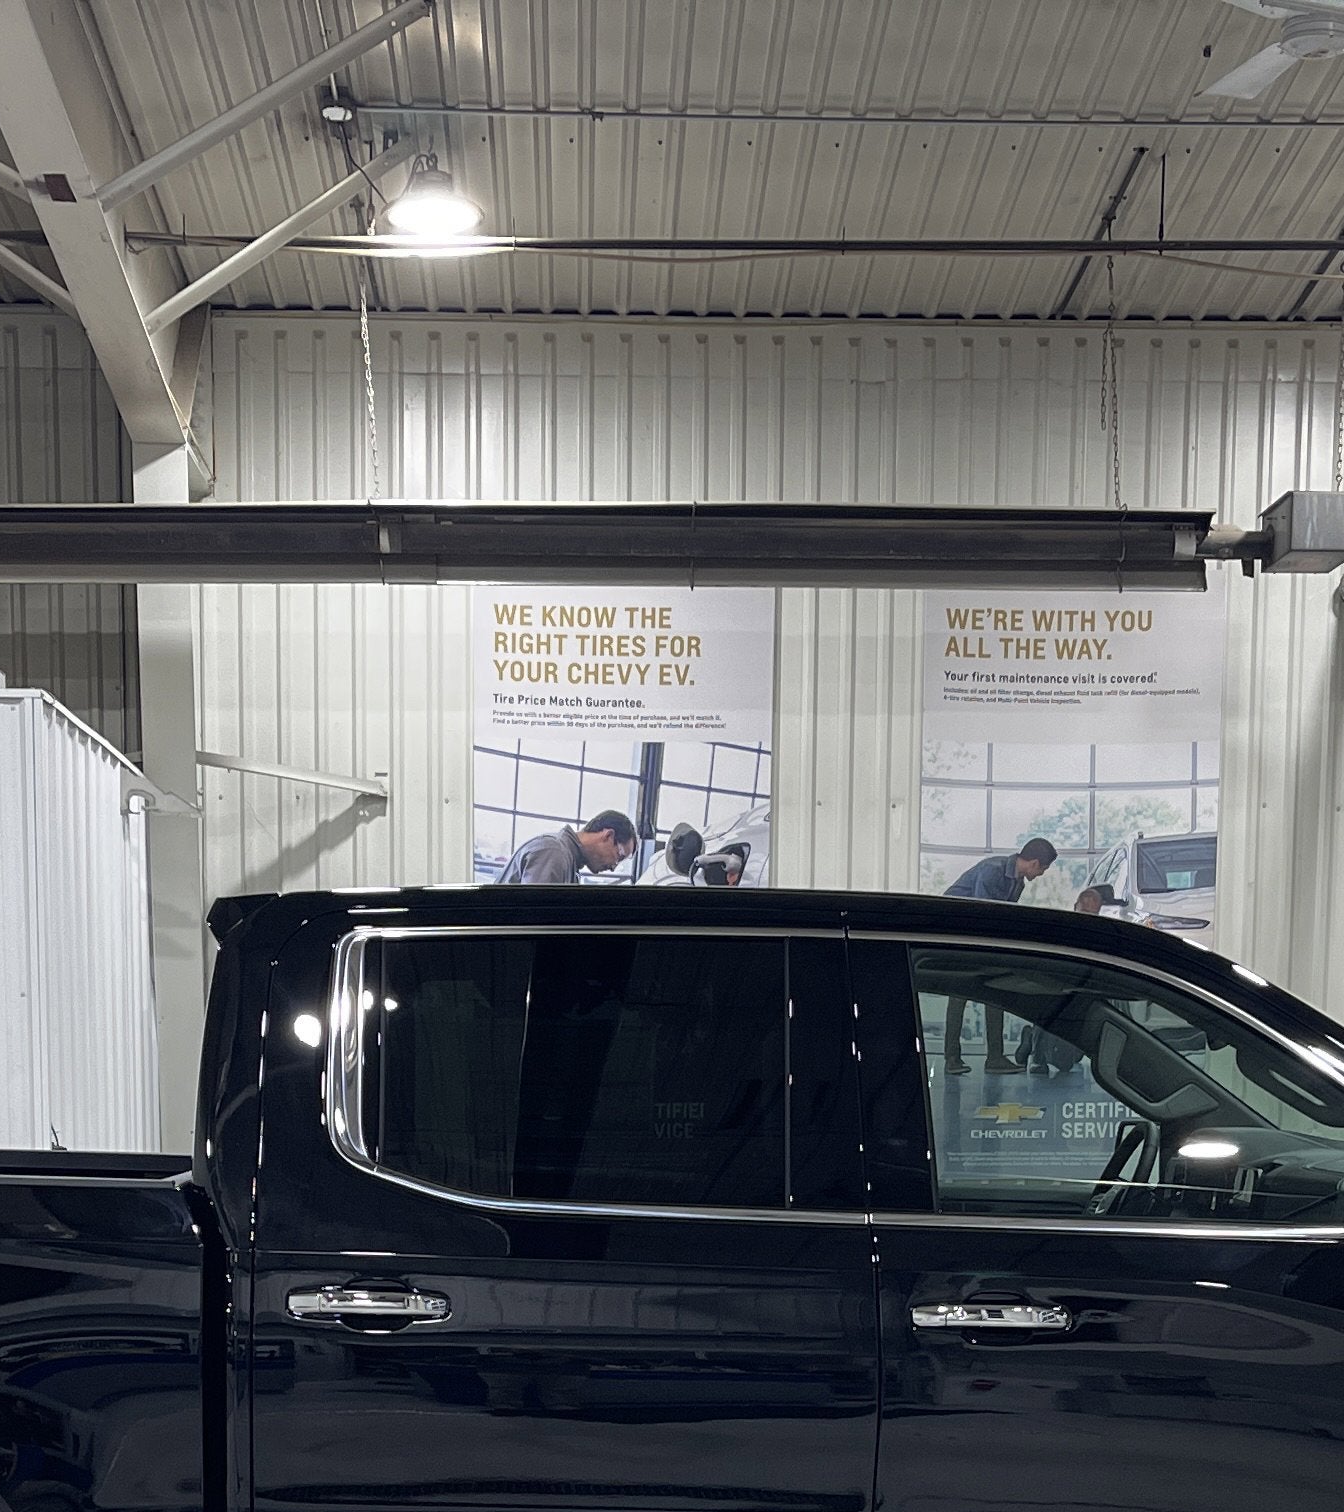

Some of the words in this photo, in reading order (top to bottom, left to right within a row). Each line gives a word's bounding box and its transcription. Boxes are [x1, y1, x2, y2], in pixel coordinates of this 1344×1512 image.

[493, 604, 532, 627] WE
[542, 606, 616, 628] KNOW
[625, 607, 672, 629] THE
[946, 608, 1024, 632] WE'RE
[1032, 610, 1096, 632] WITH
[1105, 610, 1152, 632] YOU
[494, 632, 568, 654] RIGHT
[576, 634, 645, 657] TIRES
[655, 636, 701, 657] FOR
[944, 637, 990, 659] ALL
[999, 638, 1045, 660] THE
[1055, 639, 1112, 660] WAY.
[493, 660, 558, 684] YOUR
[568, 662, 651, 685] CHEVY
[659, 664, 695, 686] EV.
[944, 670, 969, 681] Your
[972, 672, 996, 682] first
[999, 673, 1069, 683] maintenance
[1072, 674, 1095, 684] visit
[1099, 673, 1107, 683] is
[493, 693, 514, 704] Tire
[518, 694, 545, 705] Price
[550, 696, 582, 706] Match
[586, 697, 645, 708] Guarantee.
[1062, 1102, 1142, 1119] CERTIFI
[971, 1130, 1048, 1138] CHEVROLET
[1062, 1122, 1122, 1138] SERVI
